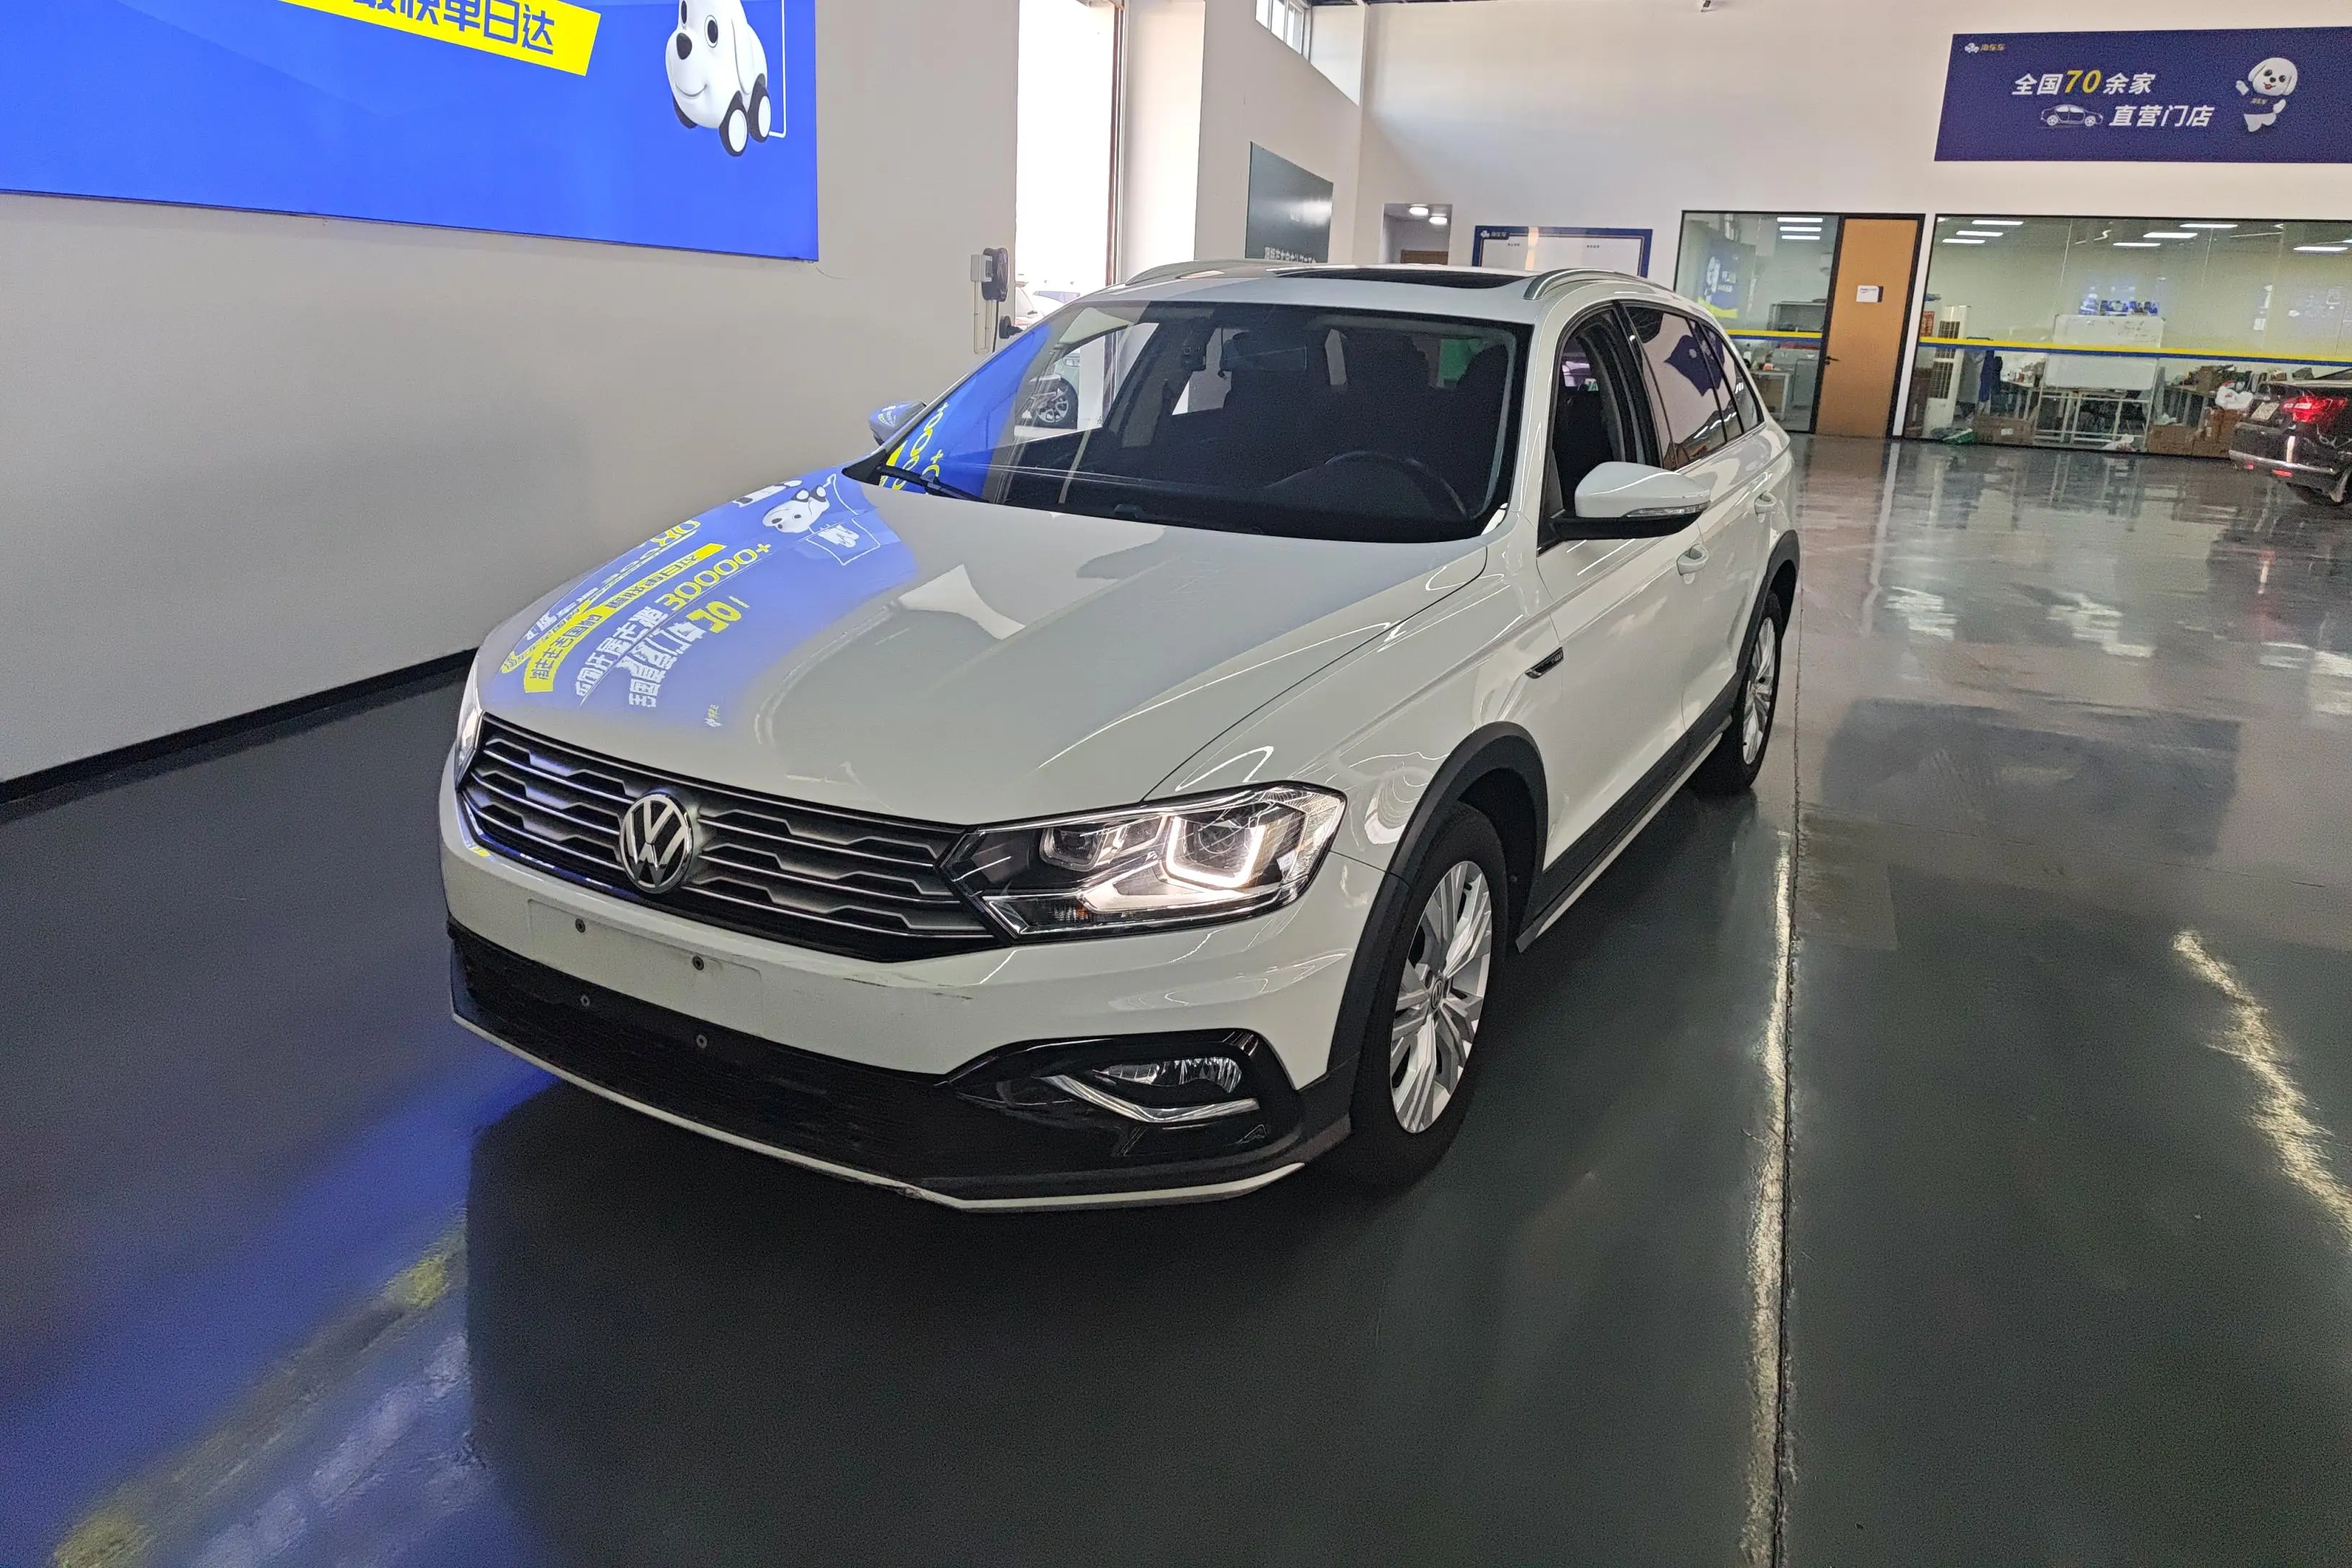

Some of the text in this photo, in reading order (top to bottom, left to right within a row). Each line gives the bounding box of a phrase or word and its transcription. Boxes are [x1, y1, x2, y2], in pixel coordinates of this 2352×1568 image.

[353, 0, 556, 55] 快单日达
[2108, 104, 2215, 127] 直营门店
